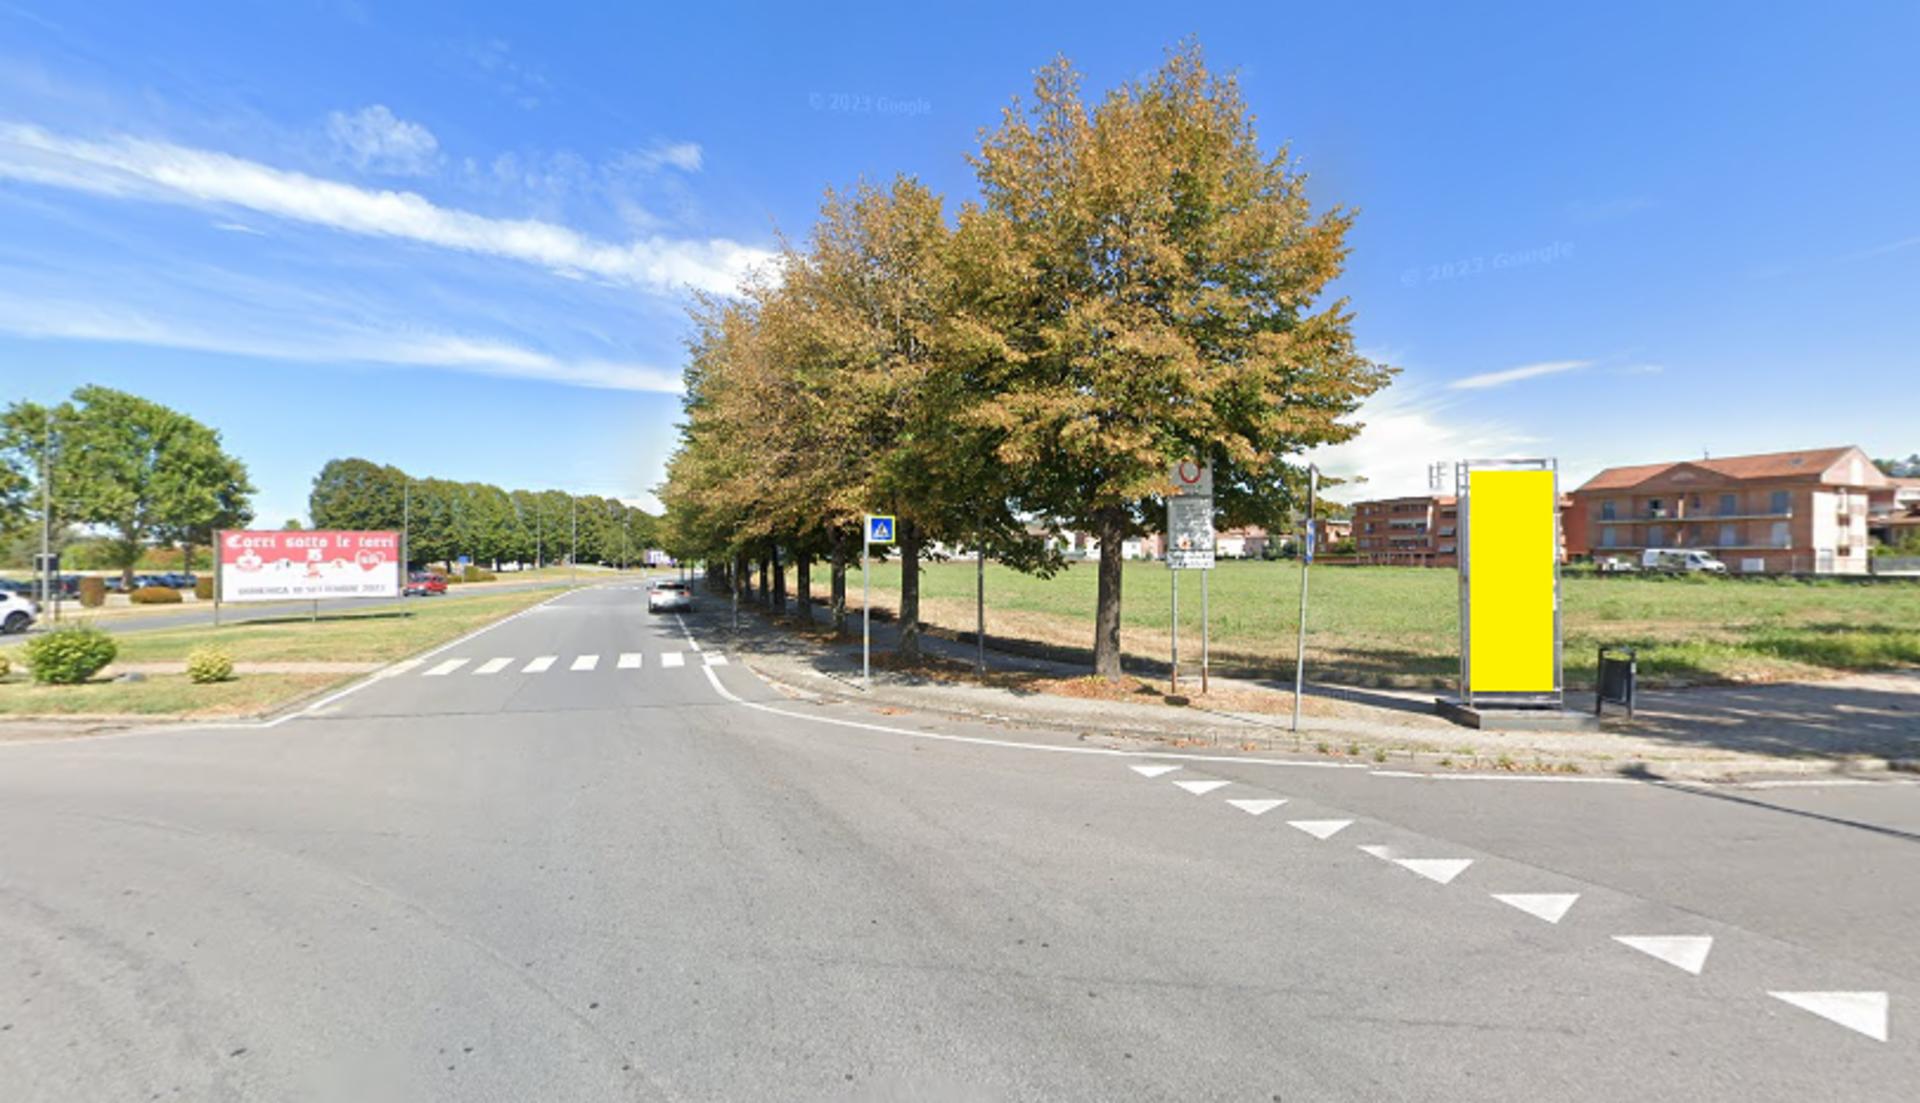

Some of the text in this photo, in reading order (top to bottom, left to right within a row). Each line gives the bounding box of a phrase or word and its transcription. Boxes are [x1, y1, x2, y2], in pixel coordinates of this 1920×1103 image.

[227, 534, 276, 549] Corri
[285, 536, 328, 549] sotto
[337, 533, 351, 548] le
